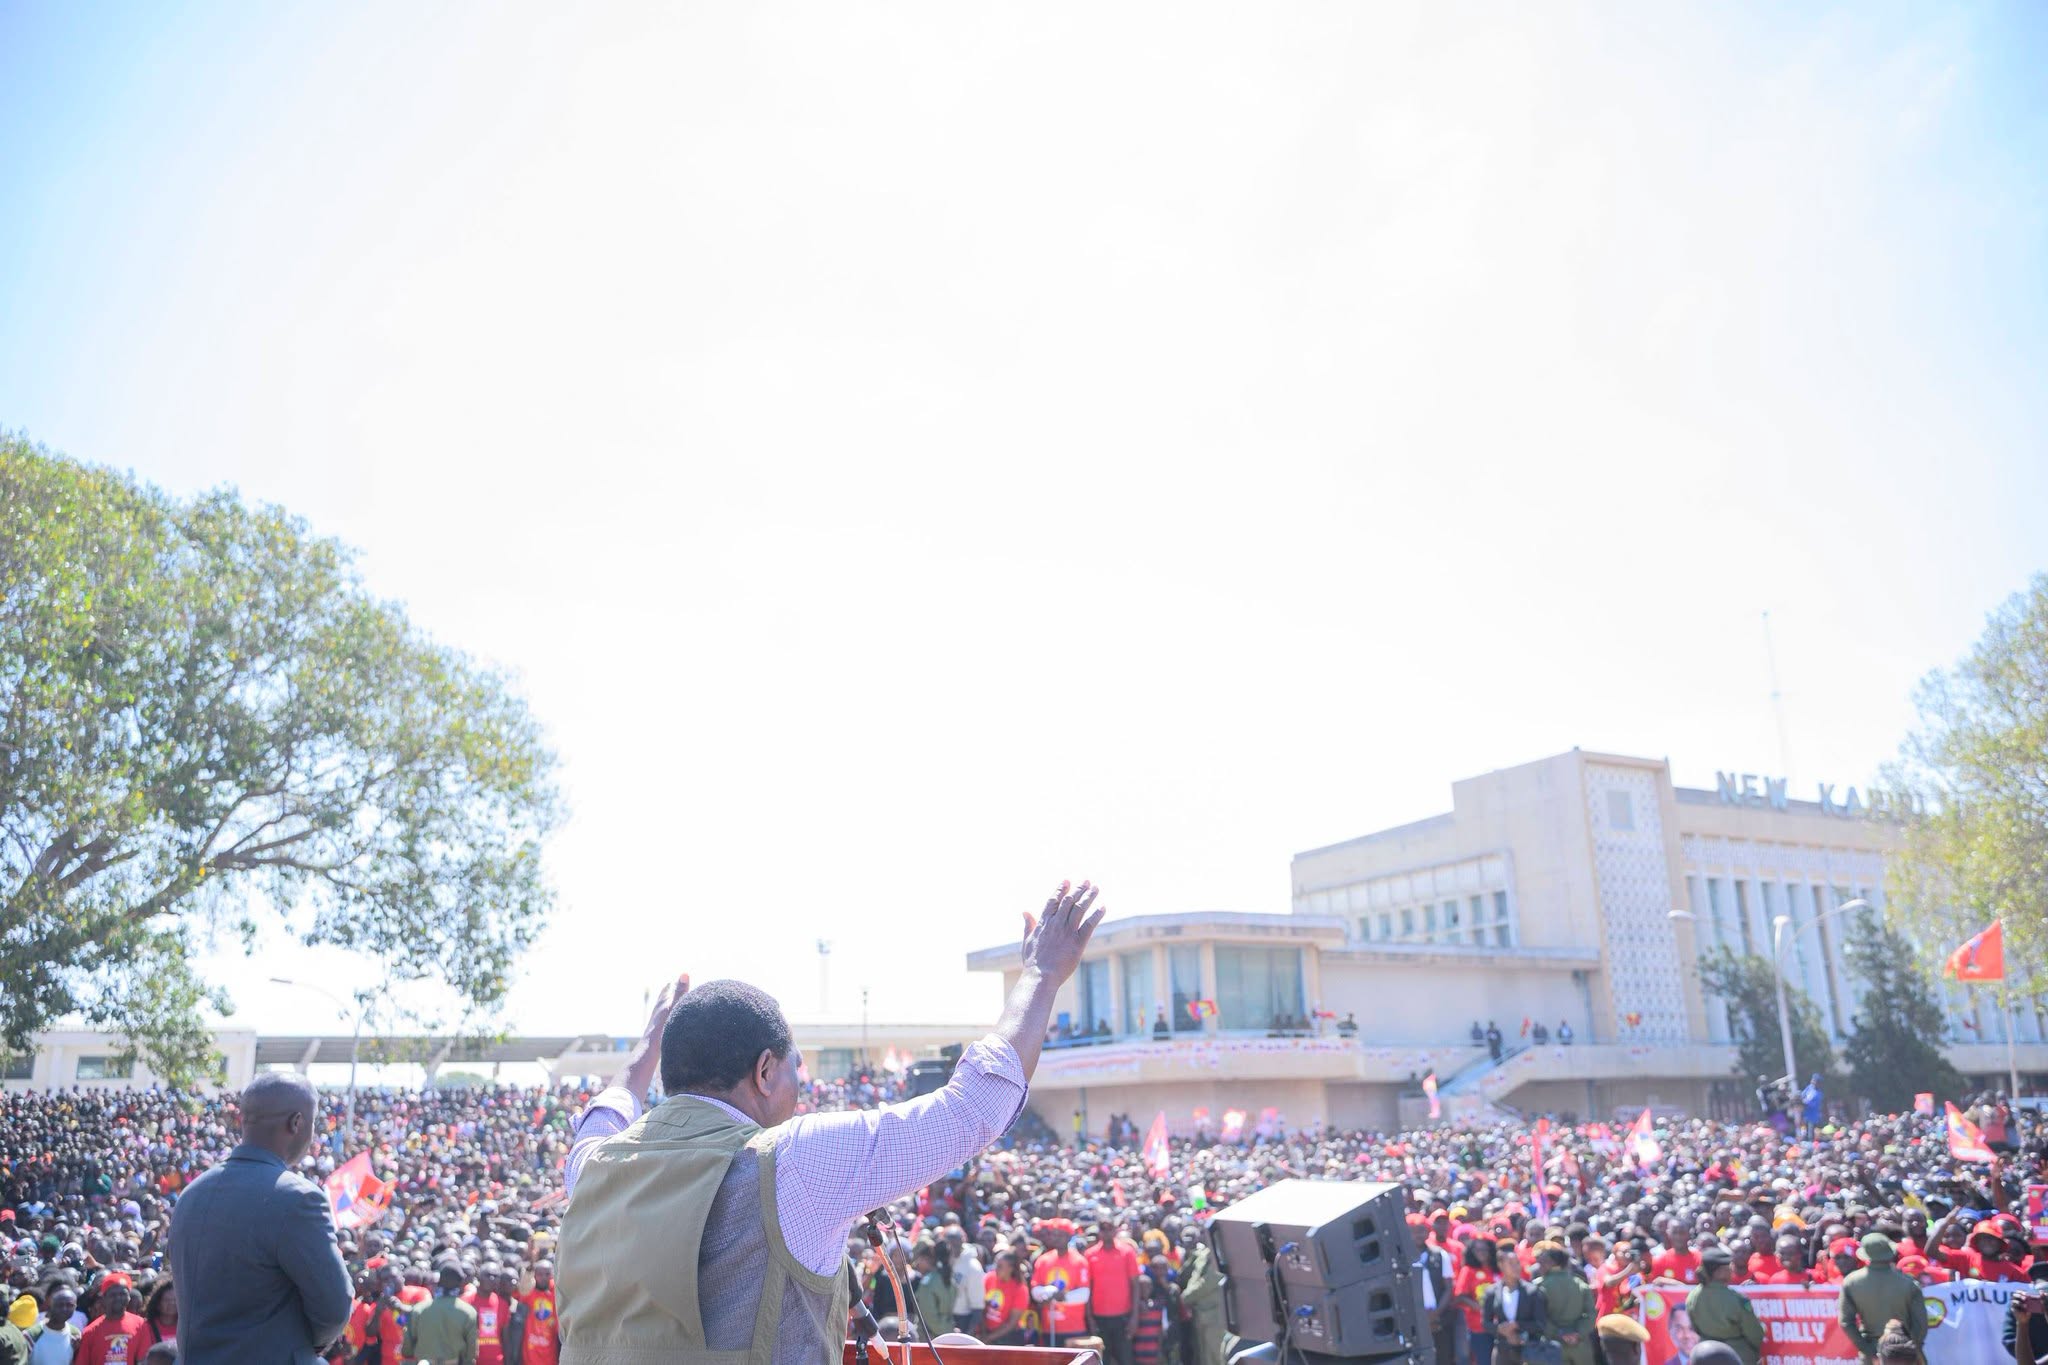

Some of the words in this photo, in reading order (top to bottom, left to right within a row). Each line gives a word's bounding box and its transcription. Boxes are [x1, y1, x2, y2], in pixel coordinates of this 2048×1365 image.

[1716, 771, 1788, 812] NEW
[1951, 1288, 2014, 1306] MULU
[1770, 1322, 1825, 1343] BALLY
